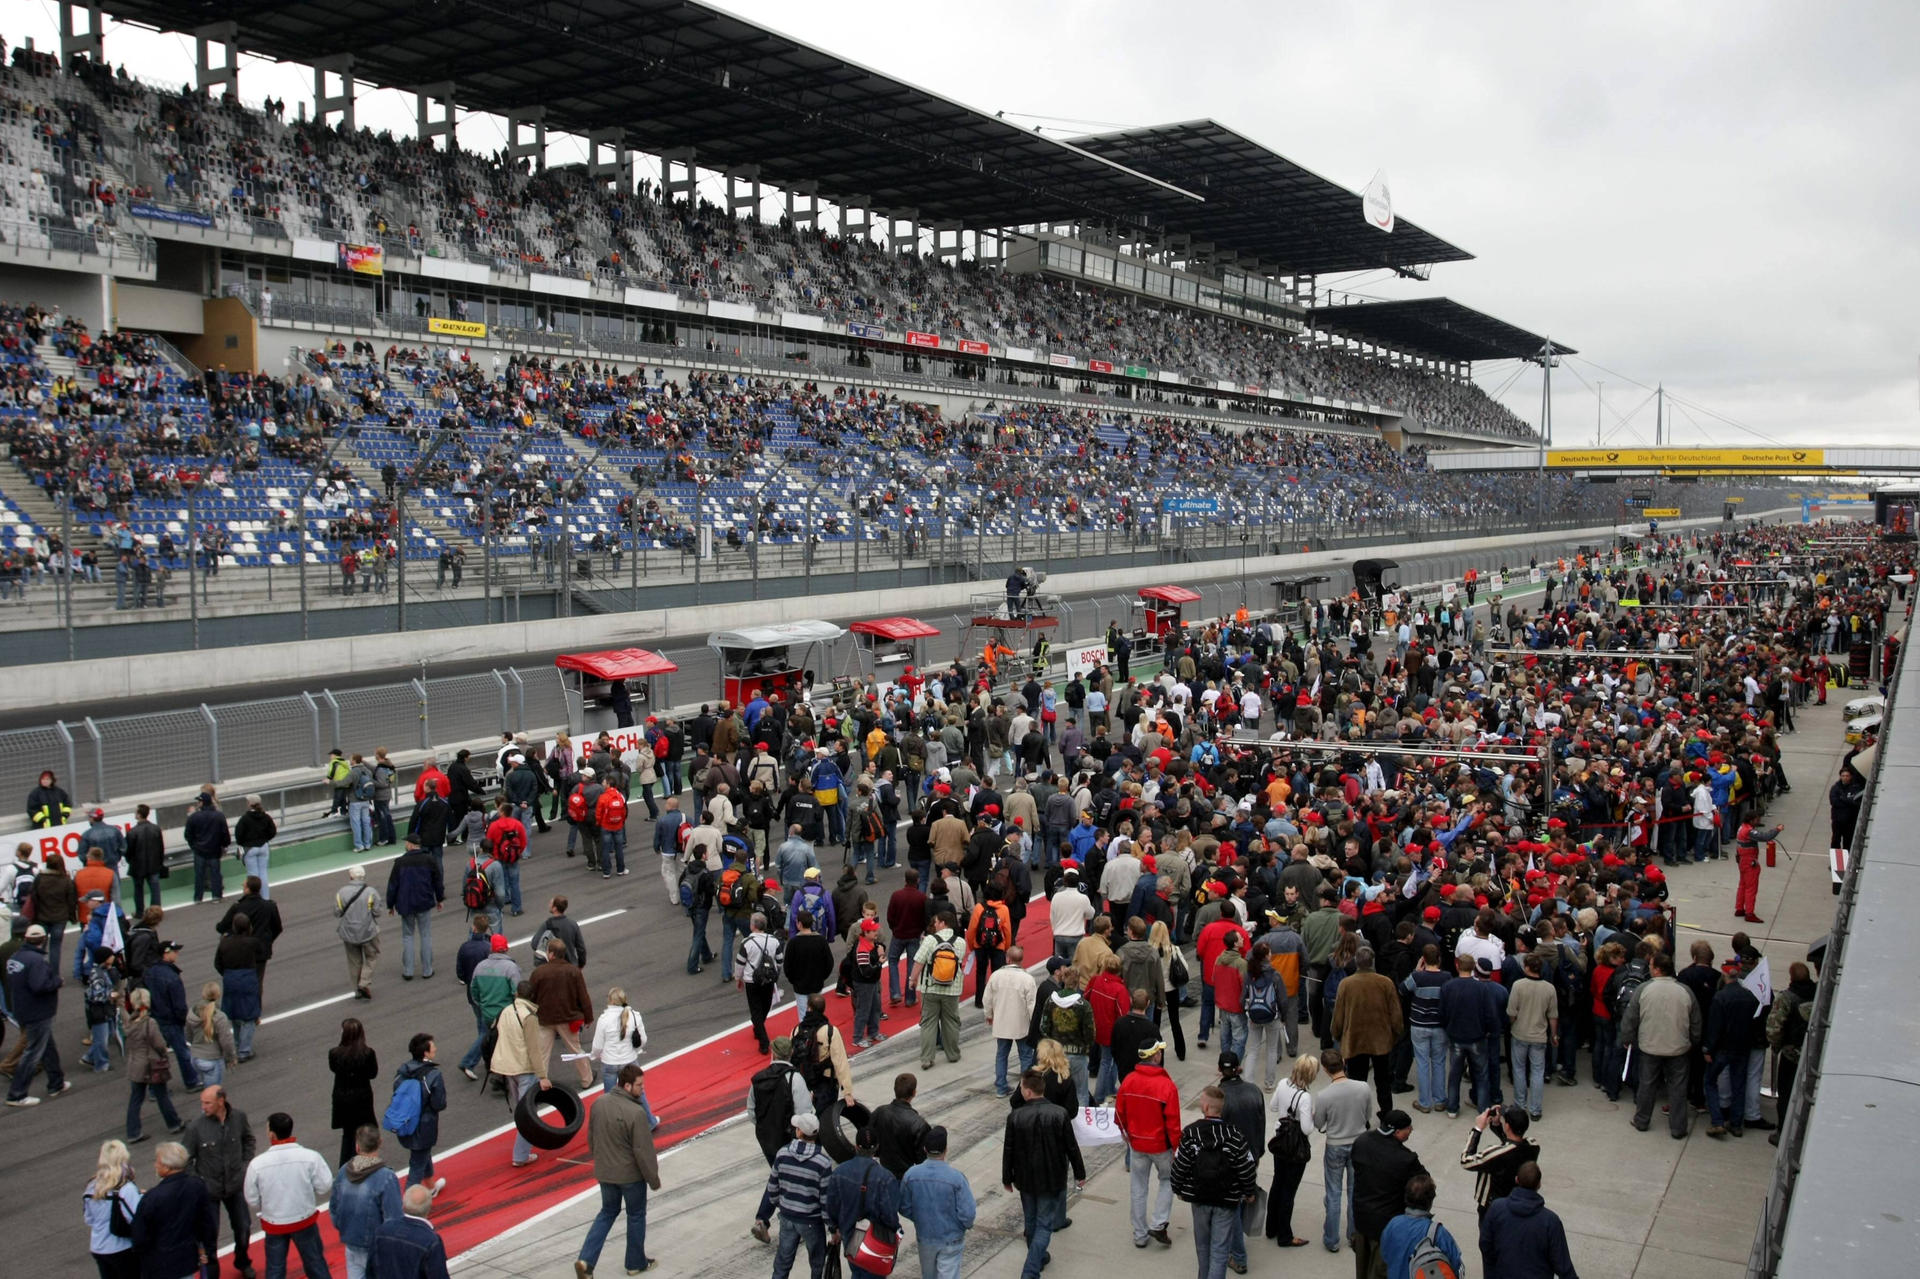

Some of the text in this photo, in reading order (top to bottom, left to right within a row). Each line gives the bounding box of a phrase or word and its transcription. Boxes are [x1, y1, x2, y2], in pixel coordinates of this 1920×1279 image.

[442, 323, 480, 332] DUNLOP
[1081, 648, 1105, 664] BOSCH
[582, 732, 639, 759] BSCH
[1085, 1106, 1093, 1125] udi
